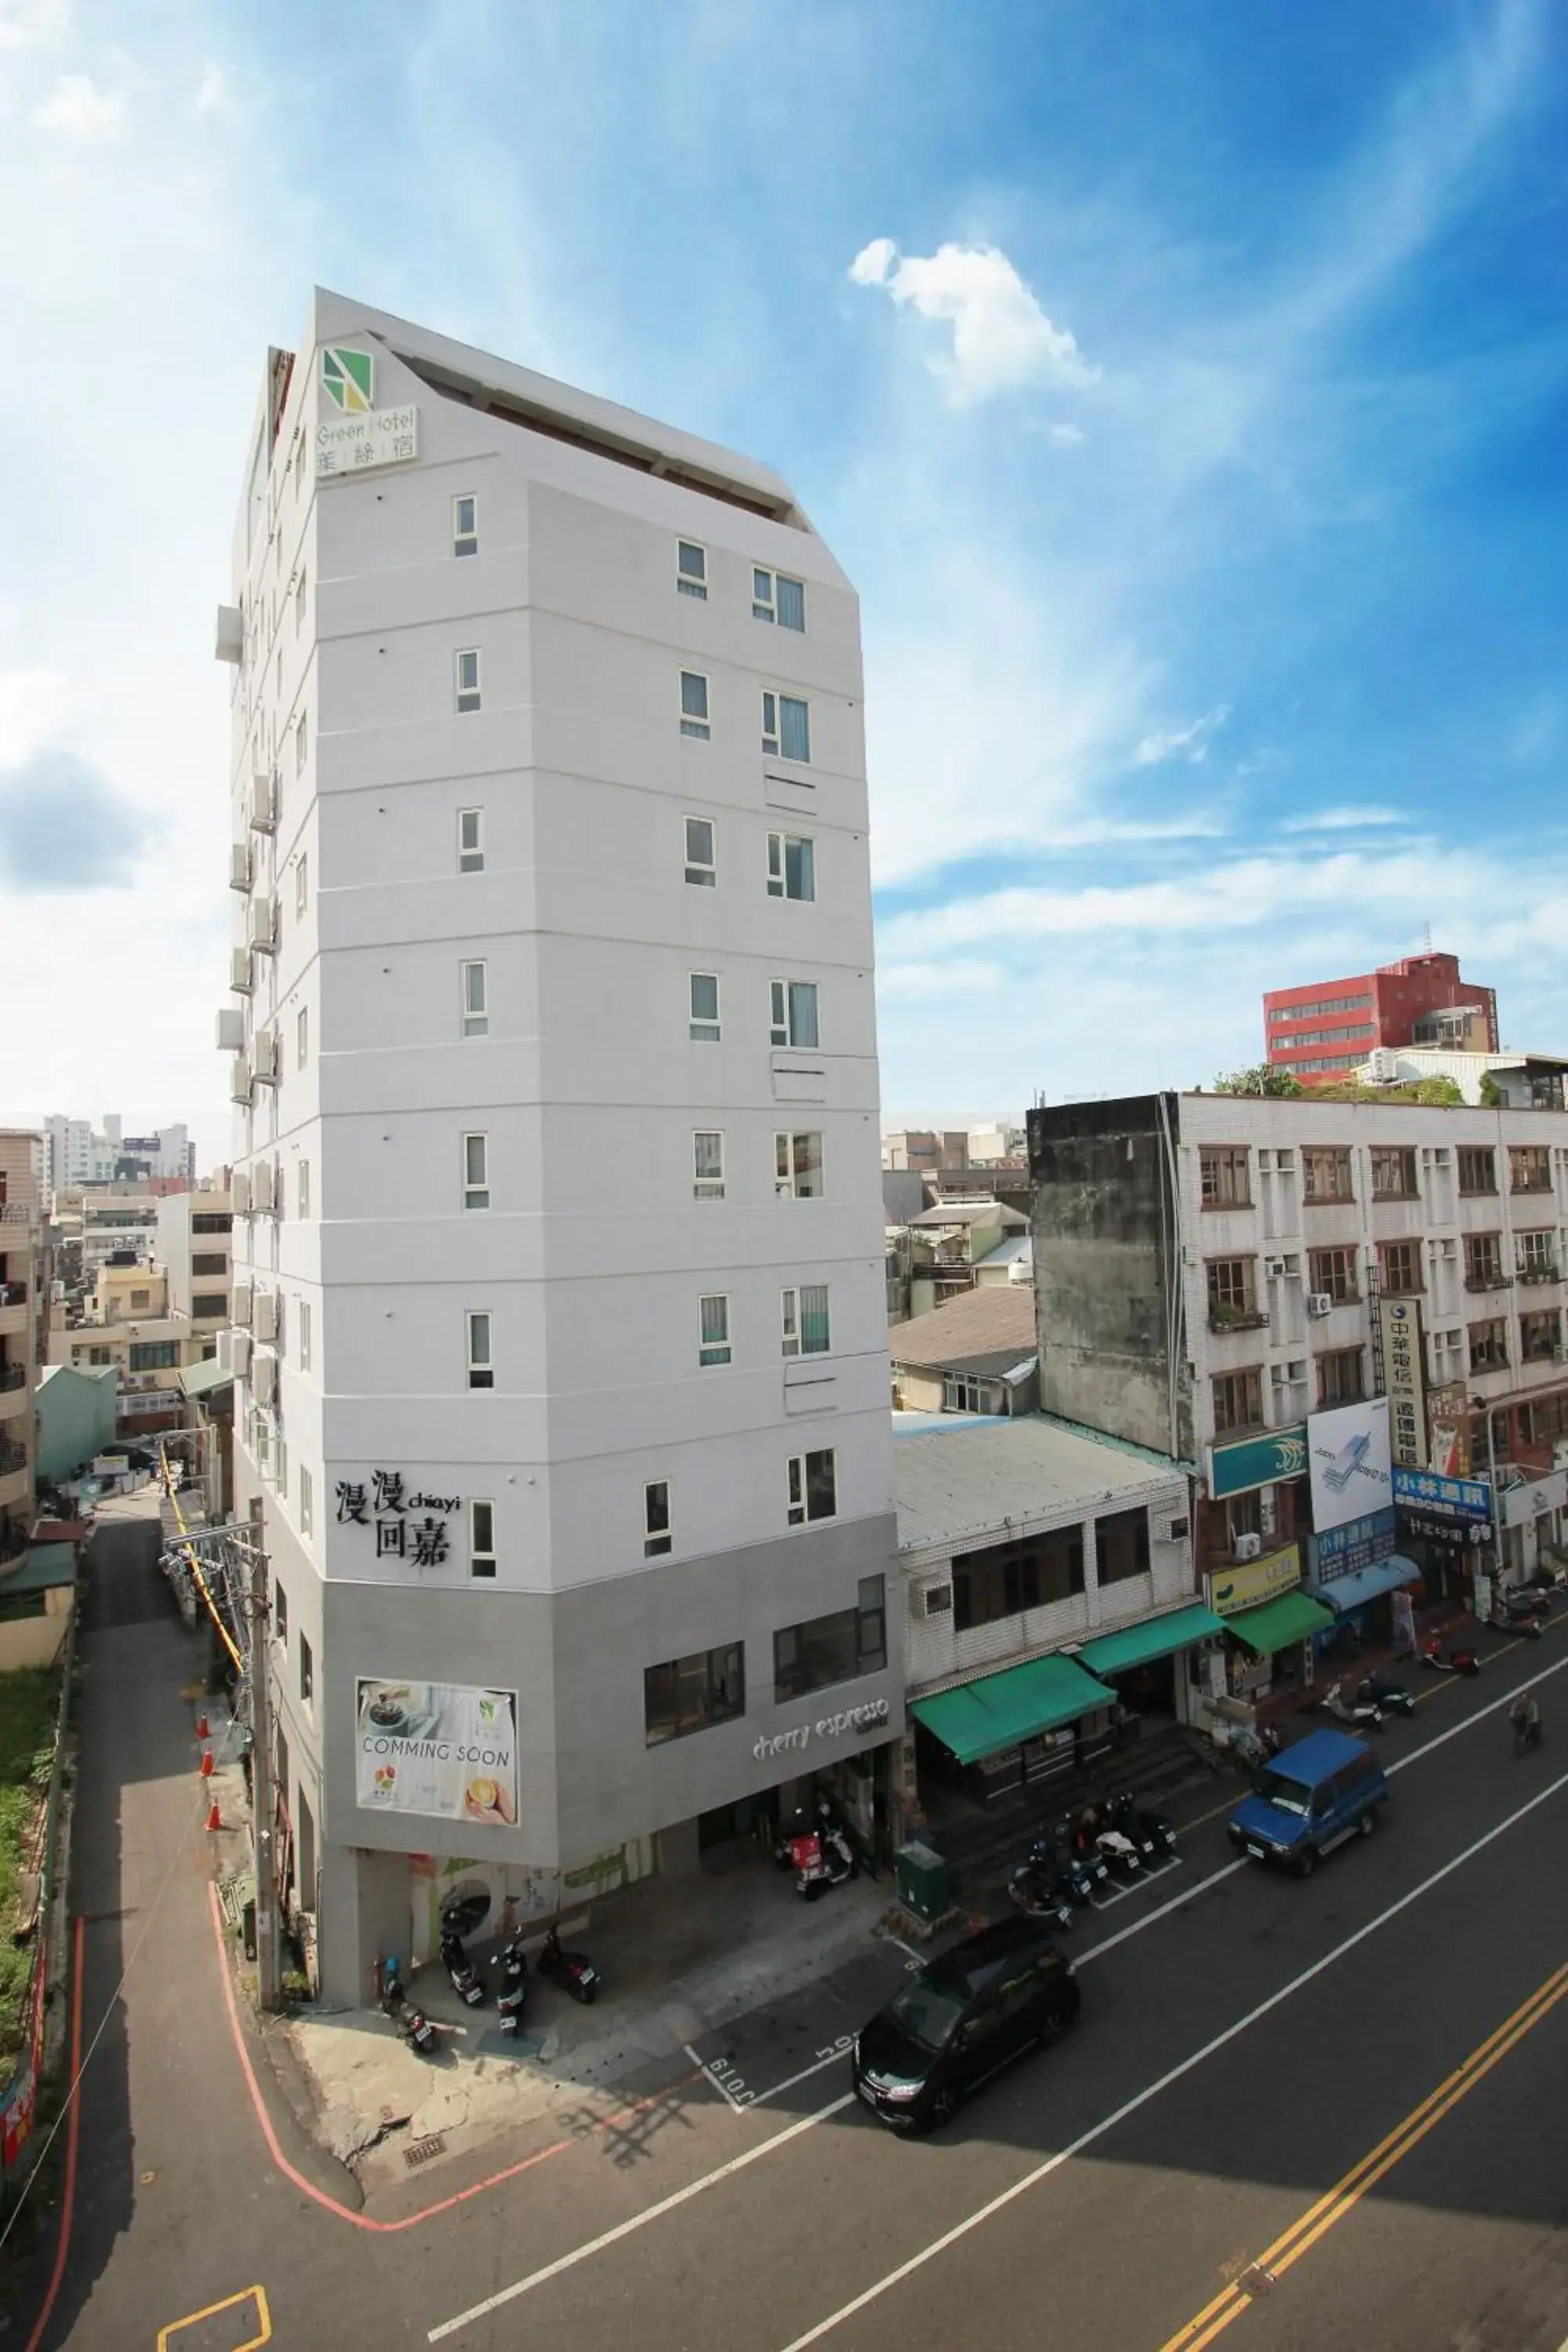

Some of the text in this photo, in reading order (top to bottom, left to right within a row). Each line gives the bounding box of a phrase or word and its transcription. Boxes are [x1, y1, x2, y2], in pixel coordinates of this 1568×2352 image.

[317, 408, 414, 446] Green Hotel
[815, 1698, 890, 1737] espresso
[363, 1737, 510, 1767] COMMING SOON
